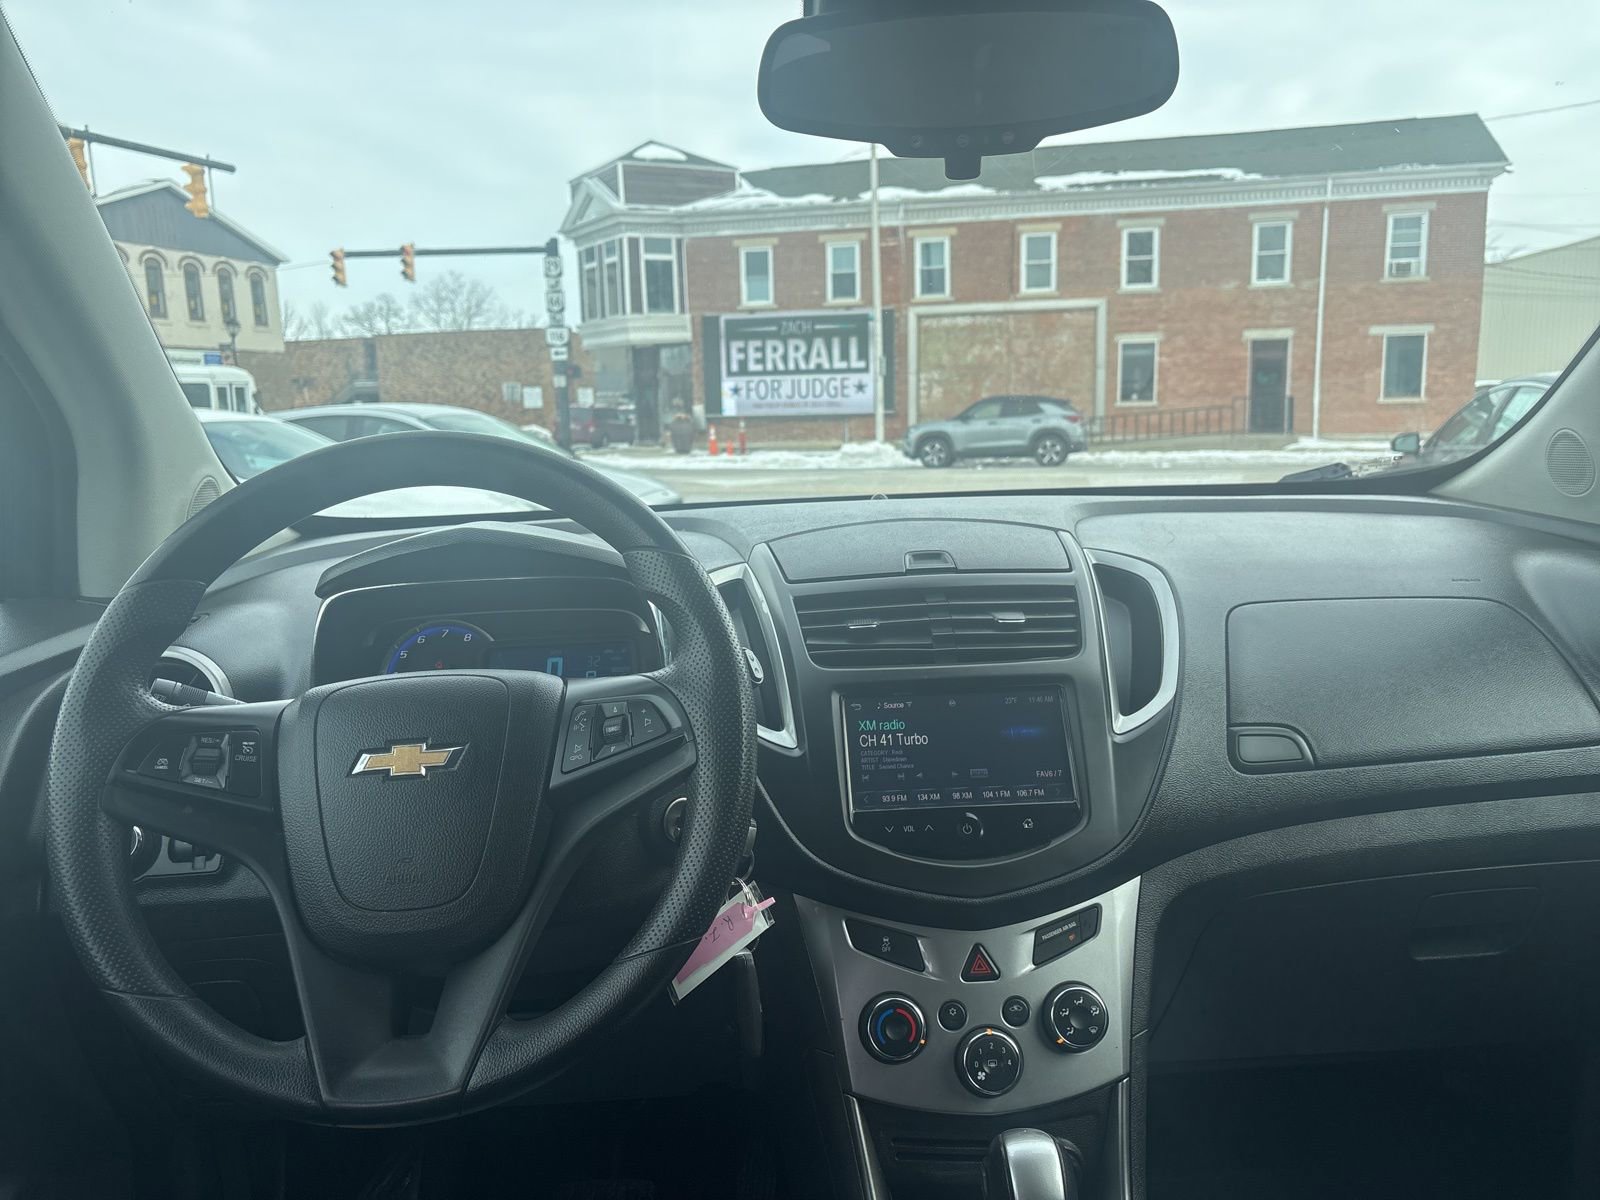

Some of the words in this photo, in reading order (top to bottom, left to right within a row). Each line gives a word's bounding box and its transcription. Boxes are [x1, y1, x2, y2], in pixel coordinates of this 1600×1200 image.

[781, 320, 813, 336] ZACH
[729, 336, 867, 373] FERRALL
[745, 378, 783, 401] FOR
[786, 376, 851, 400] JUDGE
[417, 634, 426, 644] 6
[440, 629, 450, 639] 7
[463, 632, 473, 642] 8
[399, 650, 409, 660] 5
[858, 720, 877, 731] XM
[879, 719, 906, 730] radio
[859, 734, 877, 747] CH
[880, 733, 893, 746] 41
[896, 732, 929, 745] Turbo
[235, 754, 257, 763] CRUISE
[903, 825, 916, 833] VOL
[1041, 927, 1063, 941] PASSENGER
[989, 1041, 995, 1050] 2
[1001, 1046, 1006, 1054] 3
[1007, 1058, 1013, 1066] 4
